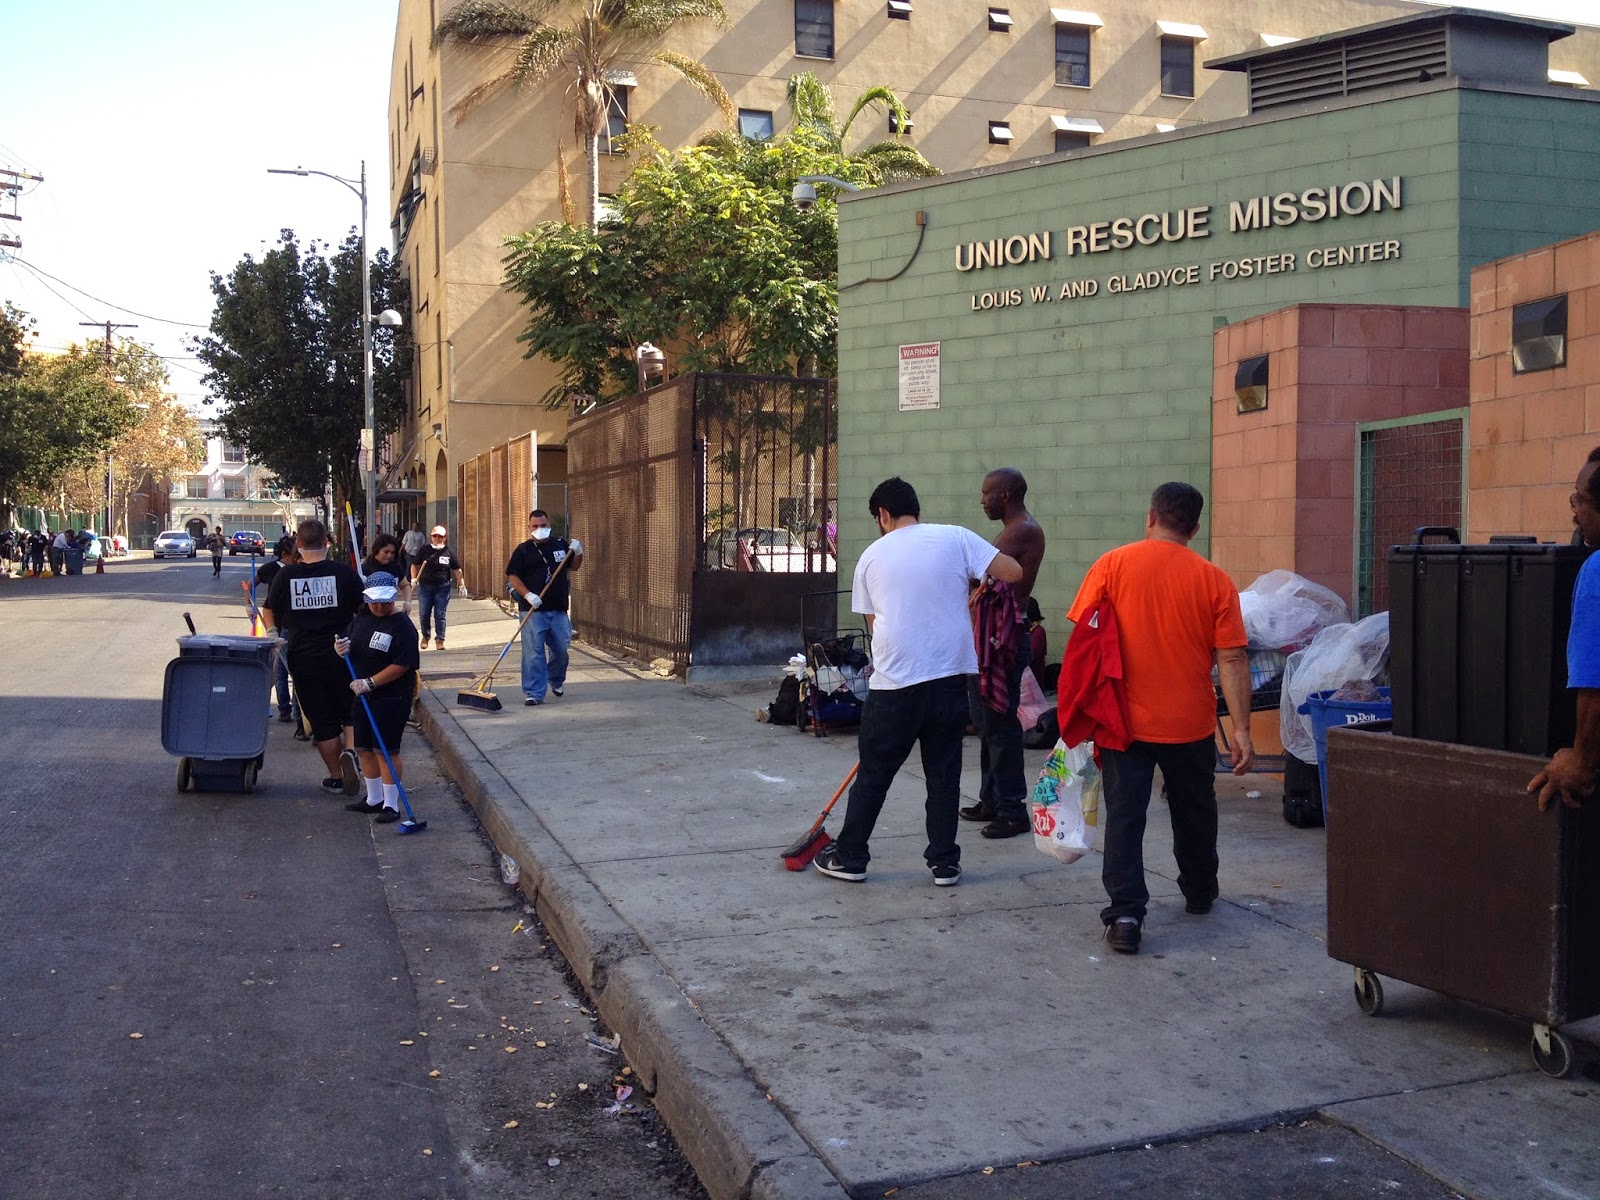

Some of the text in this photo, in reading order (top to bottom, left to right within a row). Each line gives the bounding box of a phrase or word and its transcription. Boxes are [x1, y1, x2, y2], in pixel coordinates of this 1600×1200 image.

[955, 175, 1402, 272] UNION RESCUE MISSION
[971, 239, 1401, 311] LOUIS W. AND GLADYCE FOSTER CENTER
[903, 347, 937, 357] WARNING
[294, 580, 312, 596] LA
[295, 595, 334, 608] CLOUD9
